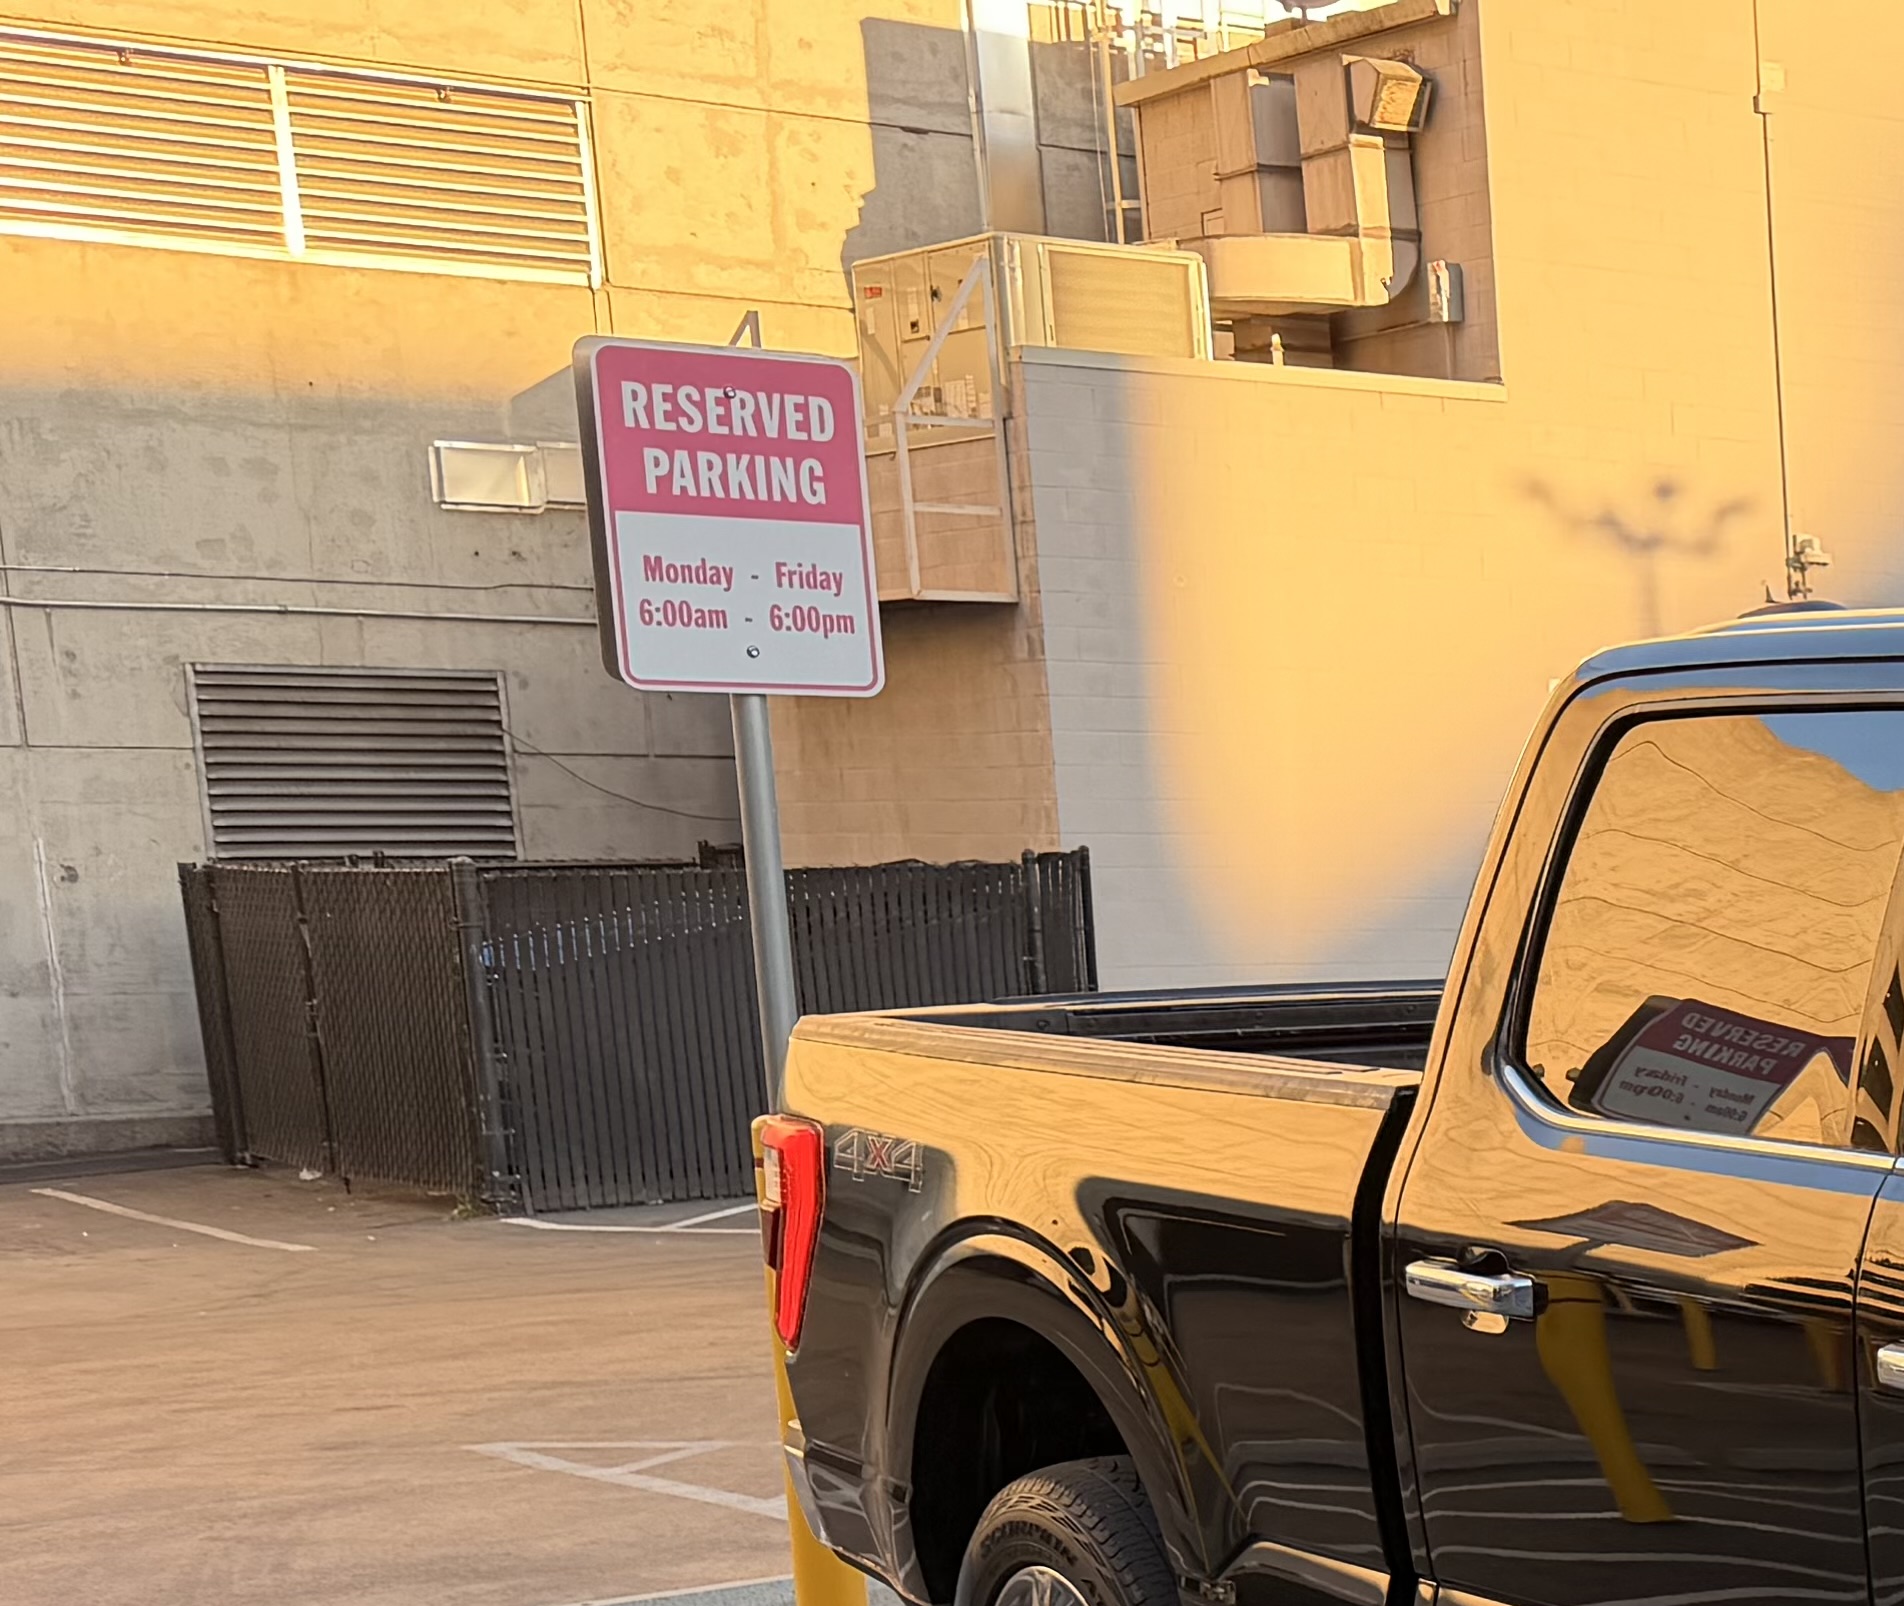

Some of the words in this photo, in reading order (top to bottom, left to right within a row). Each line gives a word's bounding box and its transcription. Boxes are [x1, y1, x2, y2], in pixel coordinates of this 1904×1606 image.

[621, 380, 835, 442] RESERVED
[643, 447, 826, 505] PARKING
[643, 554, 733, 592] Monday
[775, 562, 843, 597] Friday
[639, 598, 728, 629] 6:00am
[770, 604, 856, 638] 6:00pm
